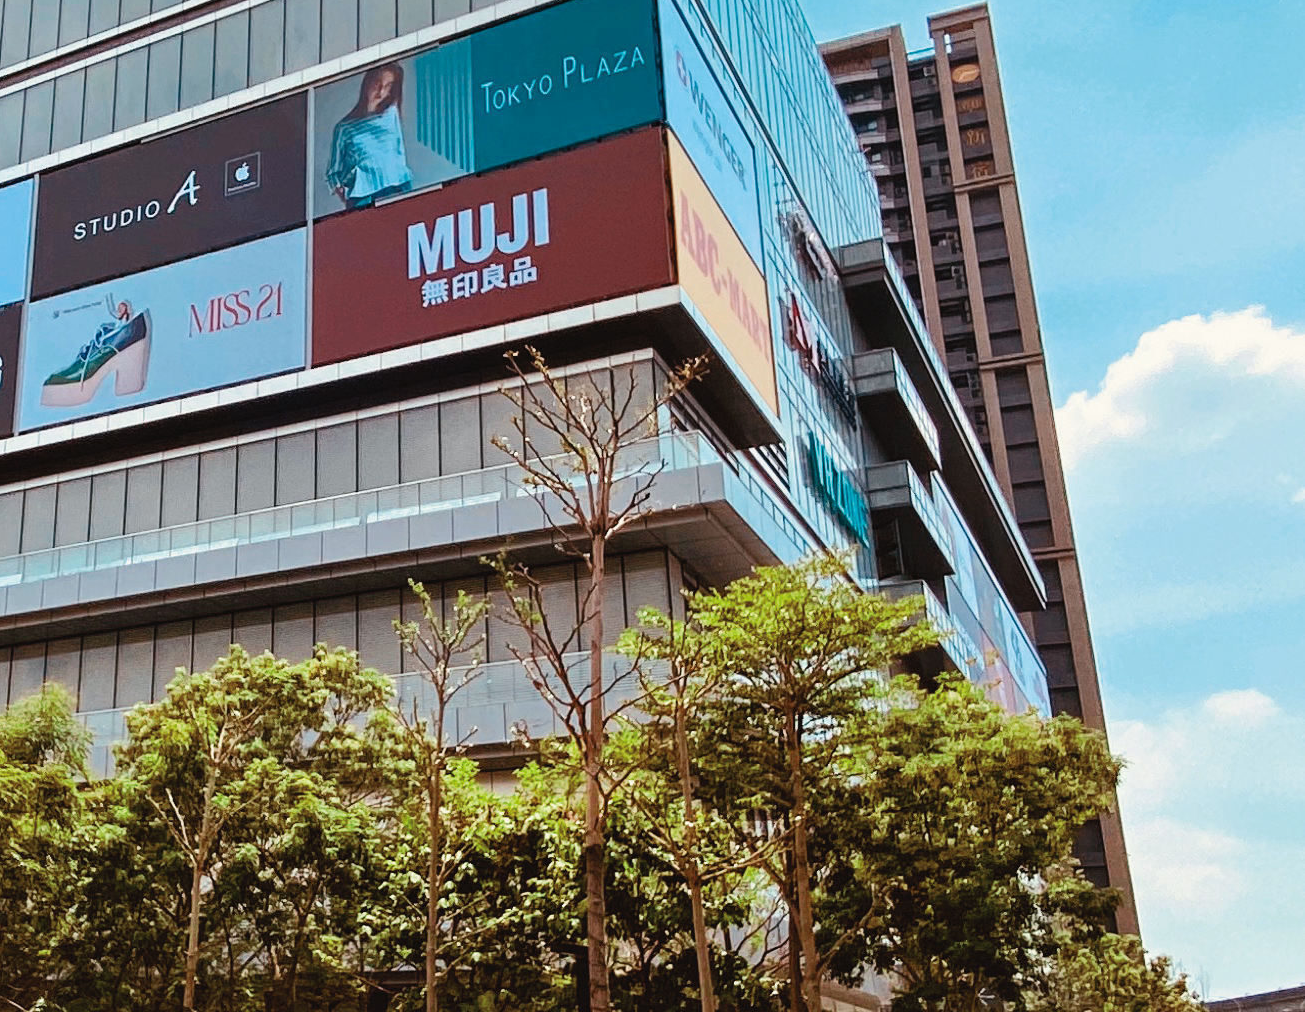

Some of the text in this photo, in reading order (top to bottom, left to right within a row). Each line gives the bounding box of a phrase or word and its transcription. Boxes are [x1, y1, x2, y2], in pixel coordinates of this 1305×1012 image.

[480, 46, 645, 114] TOKYO PLAZA
[688, 69, 748, 191] WENGER
[73, 169, 201, 241] STUDIO A
[407, 187, 550, 280] MUJI
[188, 281, 283, 338] MISS 21
[421, 255, 538, 308] 無印良品
[680, 188, 770, 364] ABC-MART
